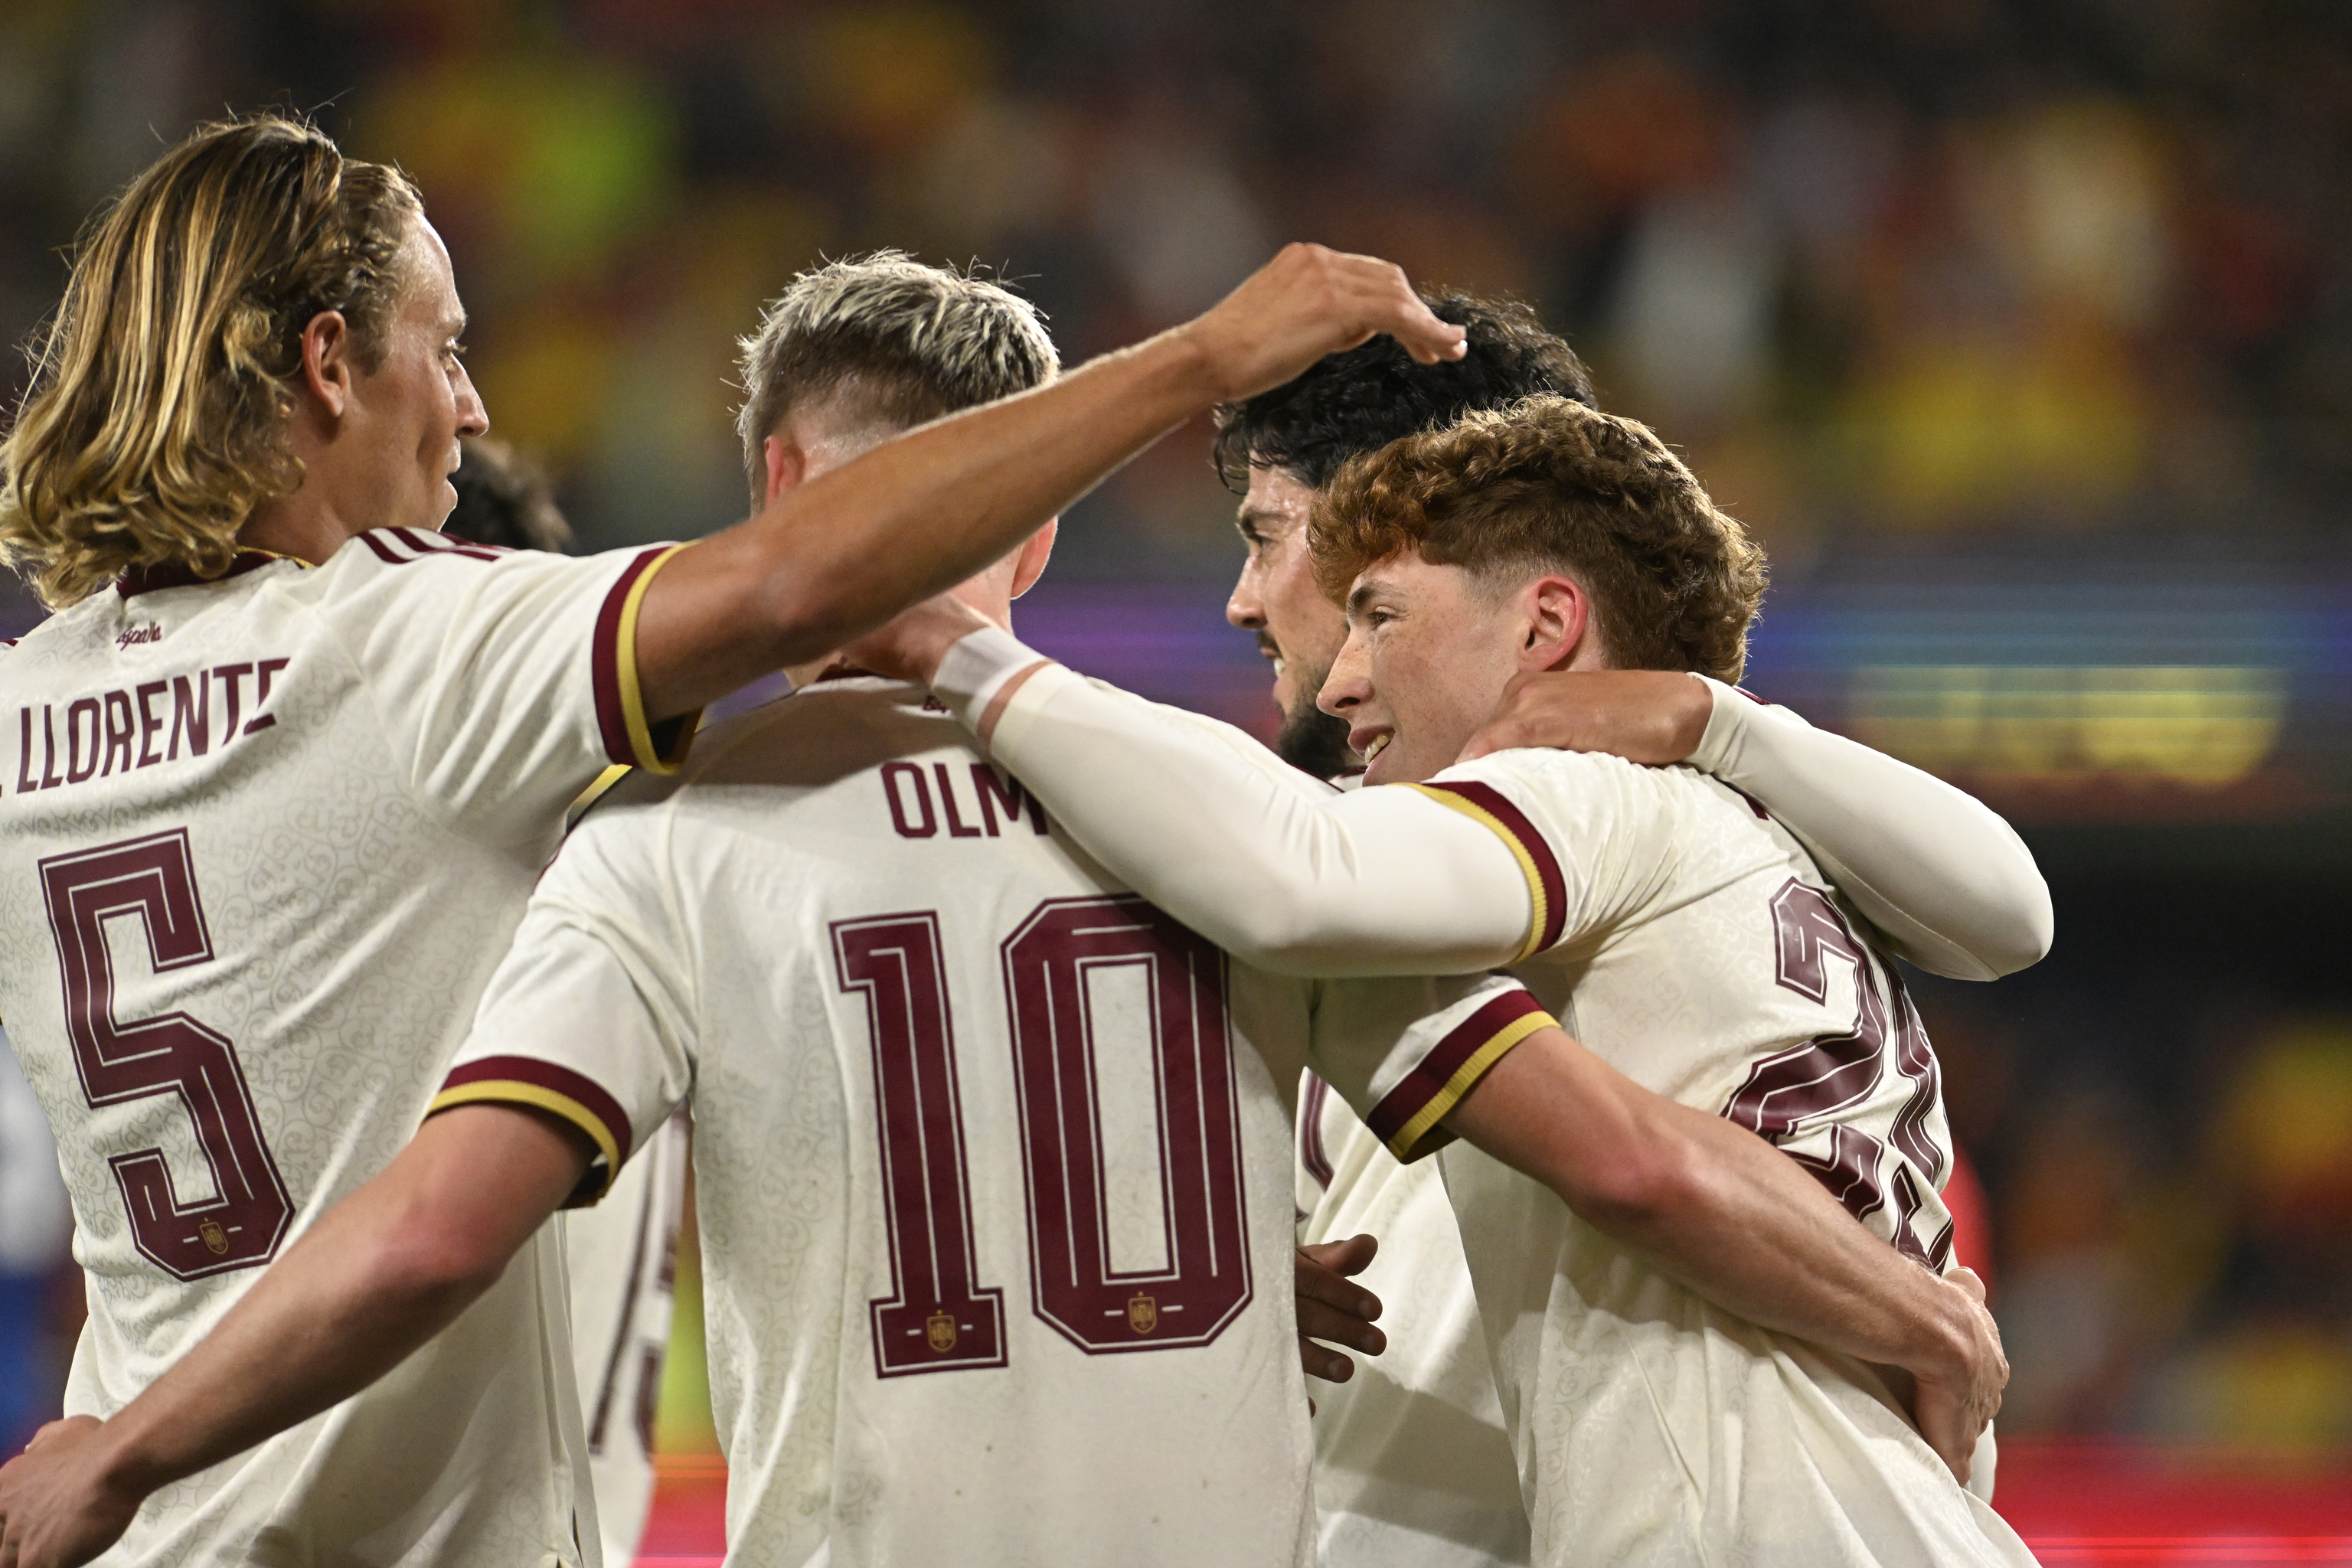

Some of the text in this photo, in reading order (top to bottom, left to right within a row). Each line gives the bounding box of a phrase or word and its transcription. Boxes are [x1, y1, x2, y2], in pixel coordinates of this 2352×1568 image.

[16, 656, 291, 794] LLORENTE
[880, 762, 1049, 838] OLM
[38, 826, 296, 1283] 5
[829, 892, 1254, 1380] 10
